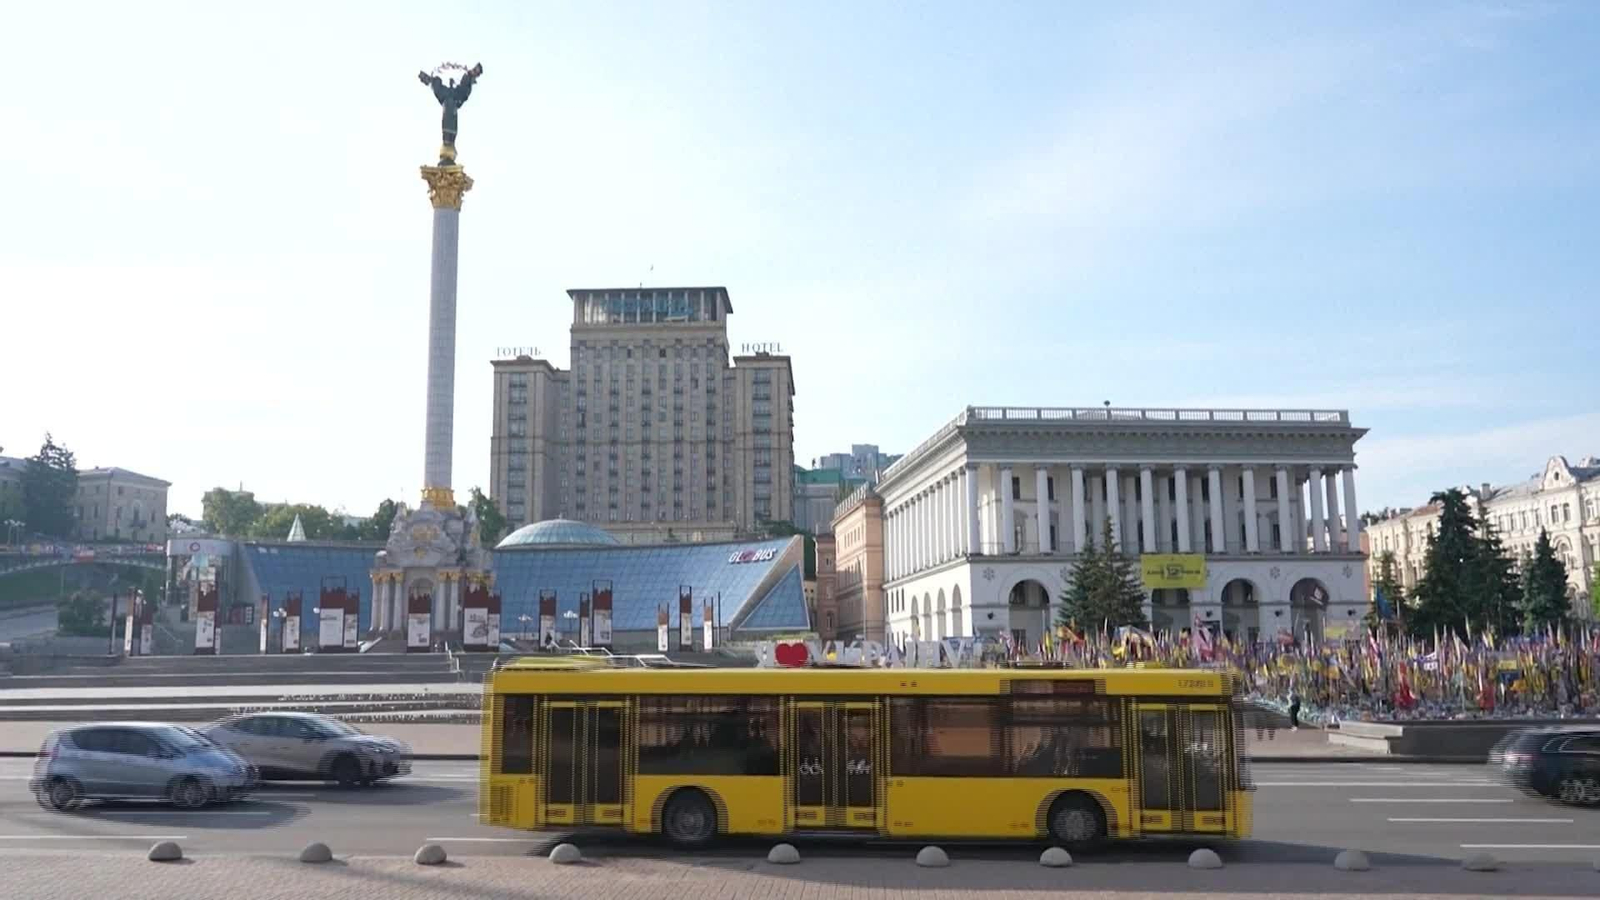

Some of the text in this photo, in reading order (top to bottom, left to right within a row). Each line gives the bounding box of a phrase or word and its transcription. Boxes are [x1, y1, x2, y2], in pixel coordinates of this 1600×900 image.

[496, 346, 541, 357] ГОТЕЛЬ
[741, 342, 783, 353] HOTEL
[728, 547, 777, 564] GLOBUS
